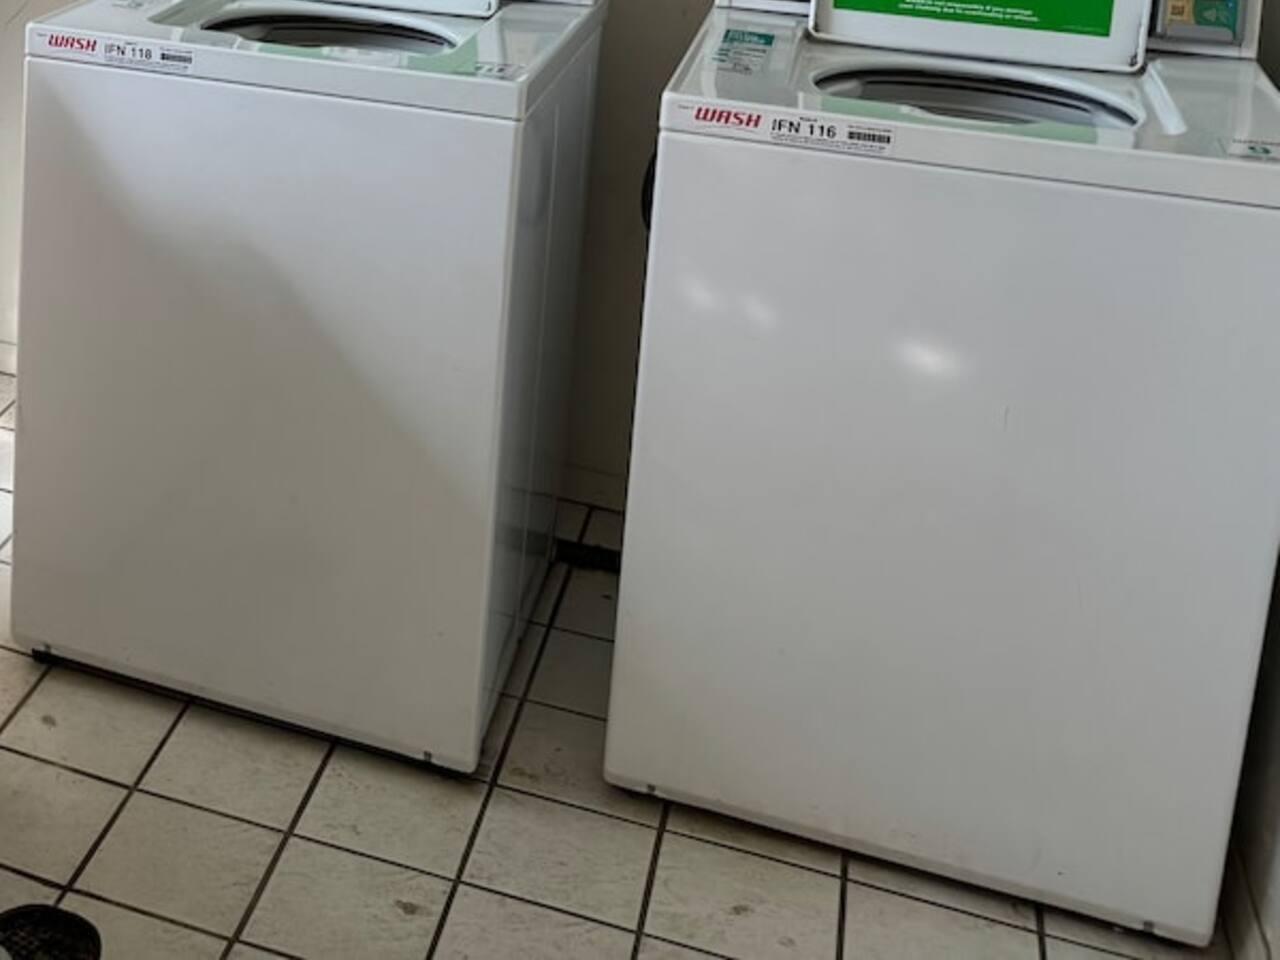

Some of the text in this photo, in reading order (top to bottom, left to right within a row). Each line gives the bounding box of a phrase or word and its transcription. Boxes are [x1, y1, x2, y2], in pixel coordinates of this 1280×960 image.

[47, 33, 98, 52] WASH
[131, 44, 153, 60] 118
[694, 105, 837, 139] WASH IFN 116
